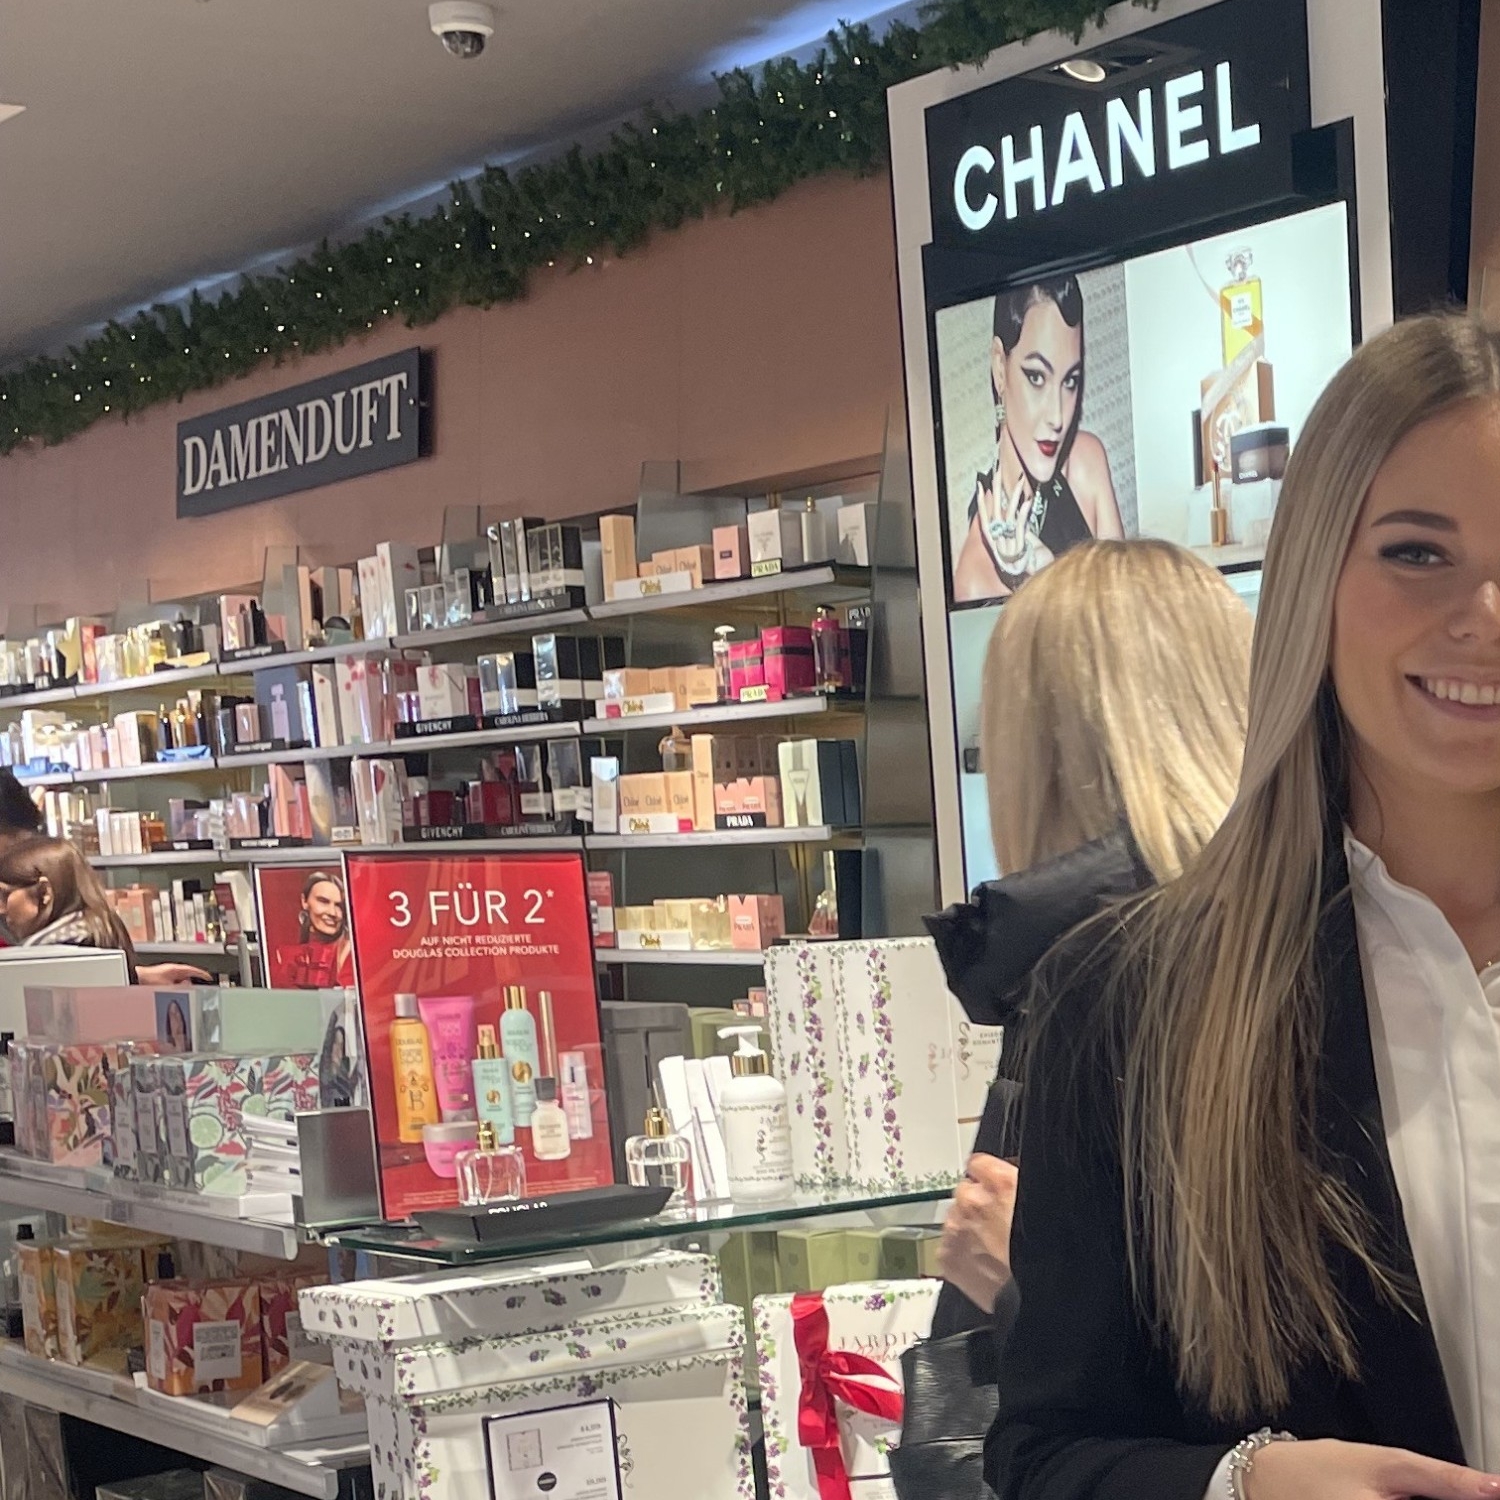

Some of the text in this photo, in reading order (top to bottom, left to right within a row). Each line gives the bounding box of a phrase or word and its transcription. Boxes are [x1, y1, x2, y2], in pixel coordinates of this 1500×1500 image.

[954, 60, 1261, 232] CHANEL
[183, 372, 411, 496] DAMENDUFT
[752, 562, 780, 575] PRADA
[415, 720, 453, 733] GIVENCHY
[726, 814, 754, 828] PRADA
[421, 827, 464, 839] GIVENCHY
[388, 890, 412, 927] 3
[429, 882, 509, 926] FÜR
[420, 934, 532, 946] AUF NICHT REDUZIERTE
[393, 944, 560, 959] DOUGLAS COLLECTION PRODUKTE
